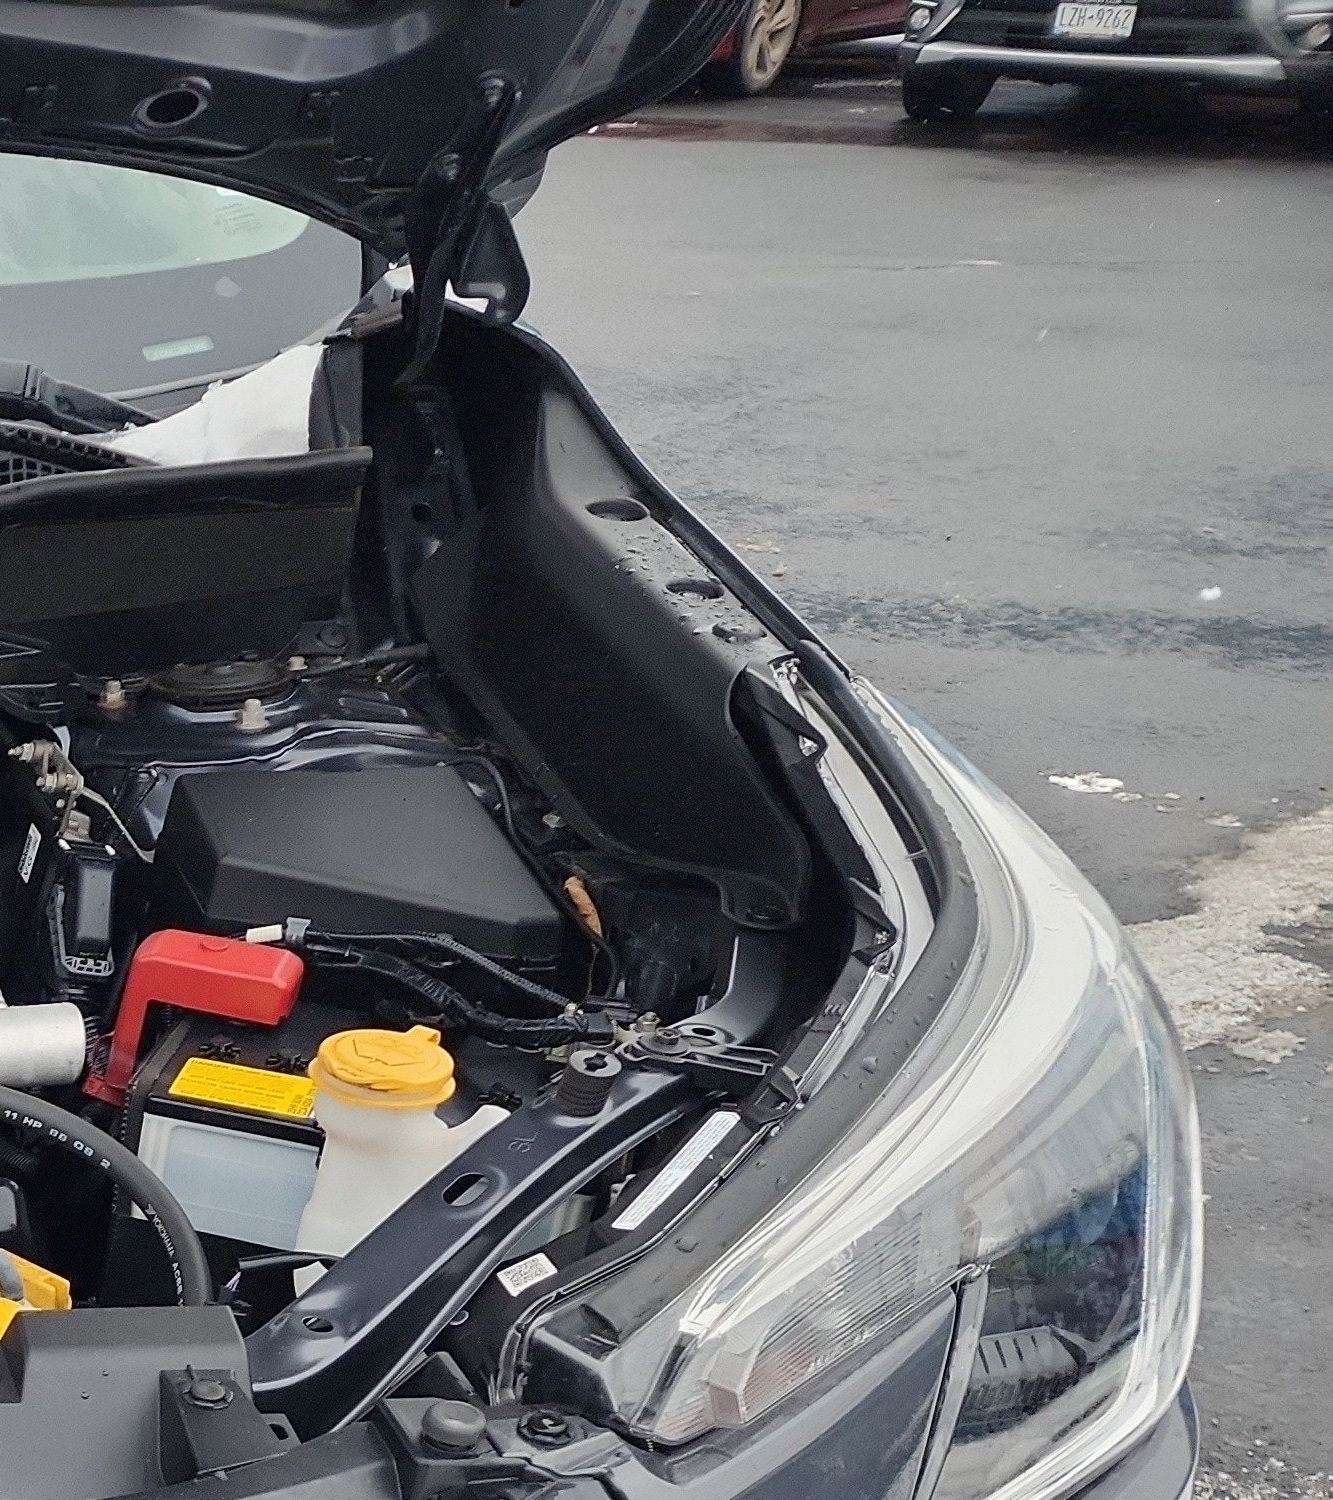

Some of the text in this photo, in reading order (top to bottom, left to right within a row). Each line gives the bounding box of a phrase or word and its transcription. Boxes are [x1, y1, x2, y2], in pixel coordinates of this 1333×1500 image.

[4, 1110, 18, 1120] 11
[22, 1116, 43, 1129] HP
[100, 1158, 111, 1169] 2
[153, 1214, 175, 1258] YOKOHAMA
